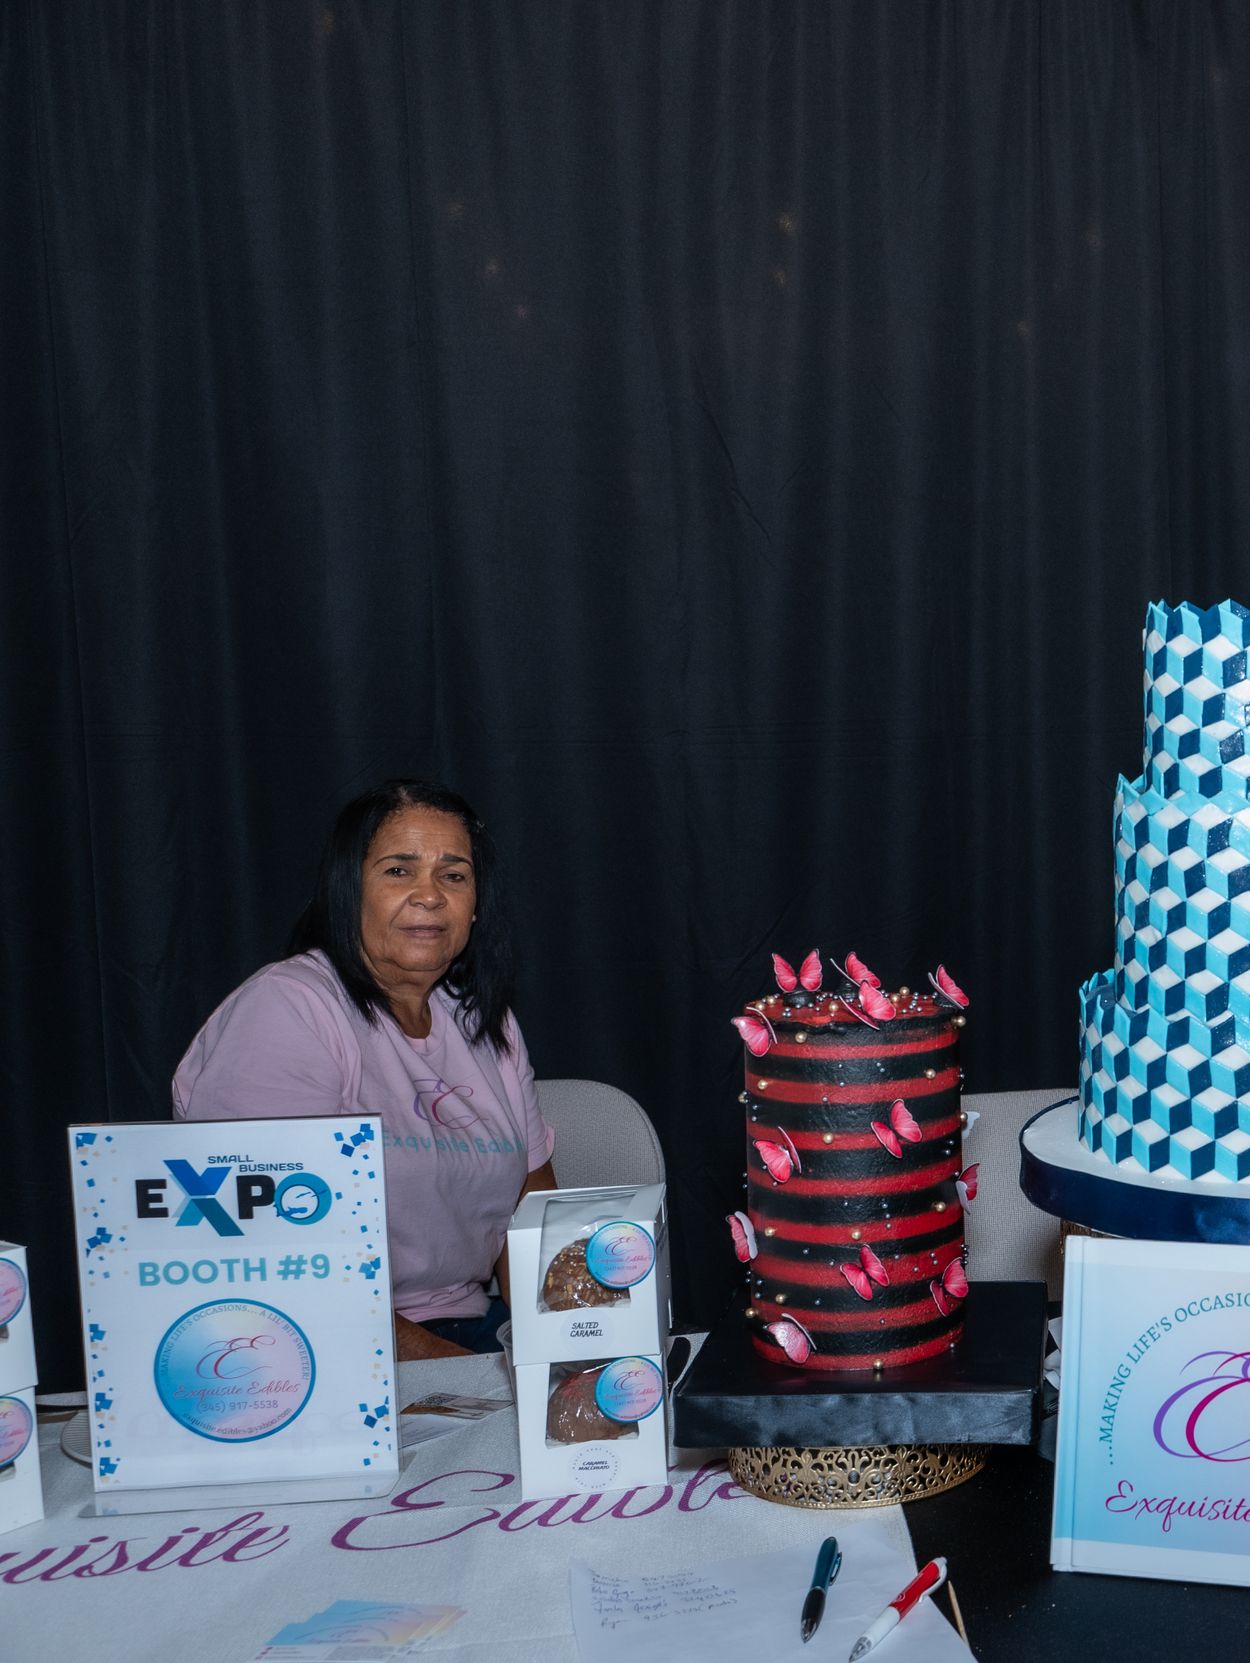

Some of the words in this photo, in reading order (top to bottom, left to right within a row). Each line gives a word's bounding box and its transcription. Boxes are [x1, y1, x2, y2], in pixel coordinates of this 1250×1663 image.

[207, 1155, 254, 1164] SMALL
[239, 1162, 304, 1173] BUSINESS
[135, 1159, 332, 1237] EXPO
[138, 1257, 268, 1287] BOOTH
[276, 1253, 331, 1281] #9
[569, 1329, 604, 1338] CARAMEL
[571, 1321, 600, 1330] SALTED
[1126, 1316, 1173, 1364] LIFE'S
[173, 1384, 242, 1401] Exquisite
[247, 1380, 301, 1395] Edibles
